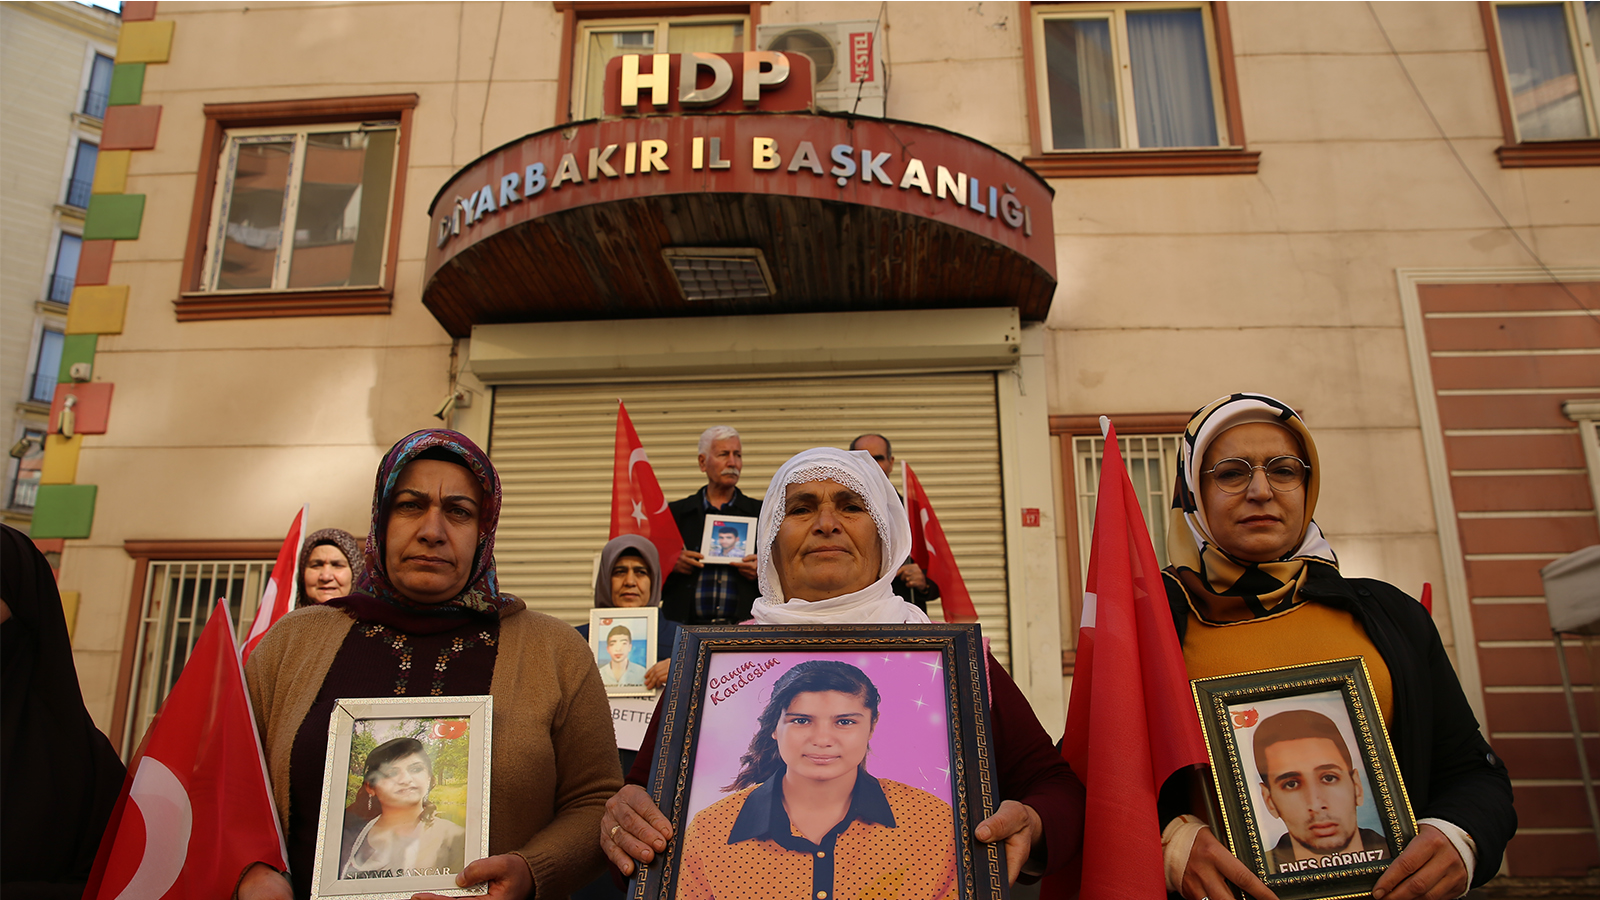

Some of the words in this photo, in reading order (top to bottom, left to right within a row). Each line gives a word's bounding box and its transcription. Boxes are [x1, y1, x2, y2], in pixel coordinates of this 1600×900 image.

[621, 51, 790, 107] HDP
[854, 33, 869, 82] VESTEL
[753, 137, 1032, 237] BAŞKANLIĞI
[1279, 859, 1319, 874] ENES
[1320, 850, 1384, 868] GÖRMEZ
